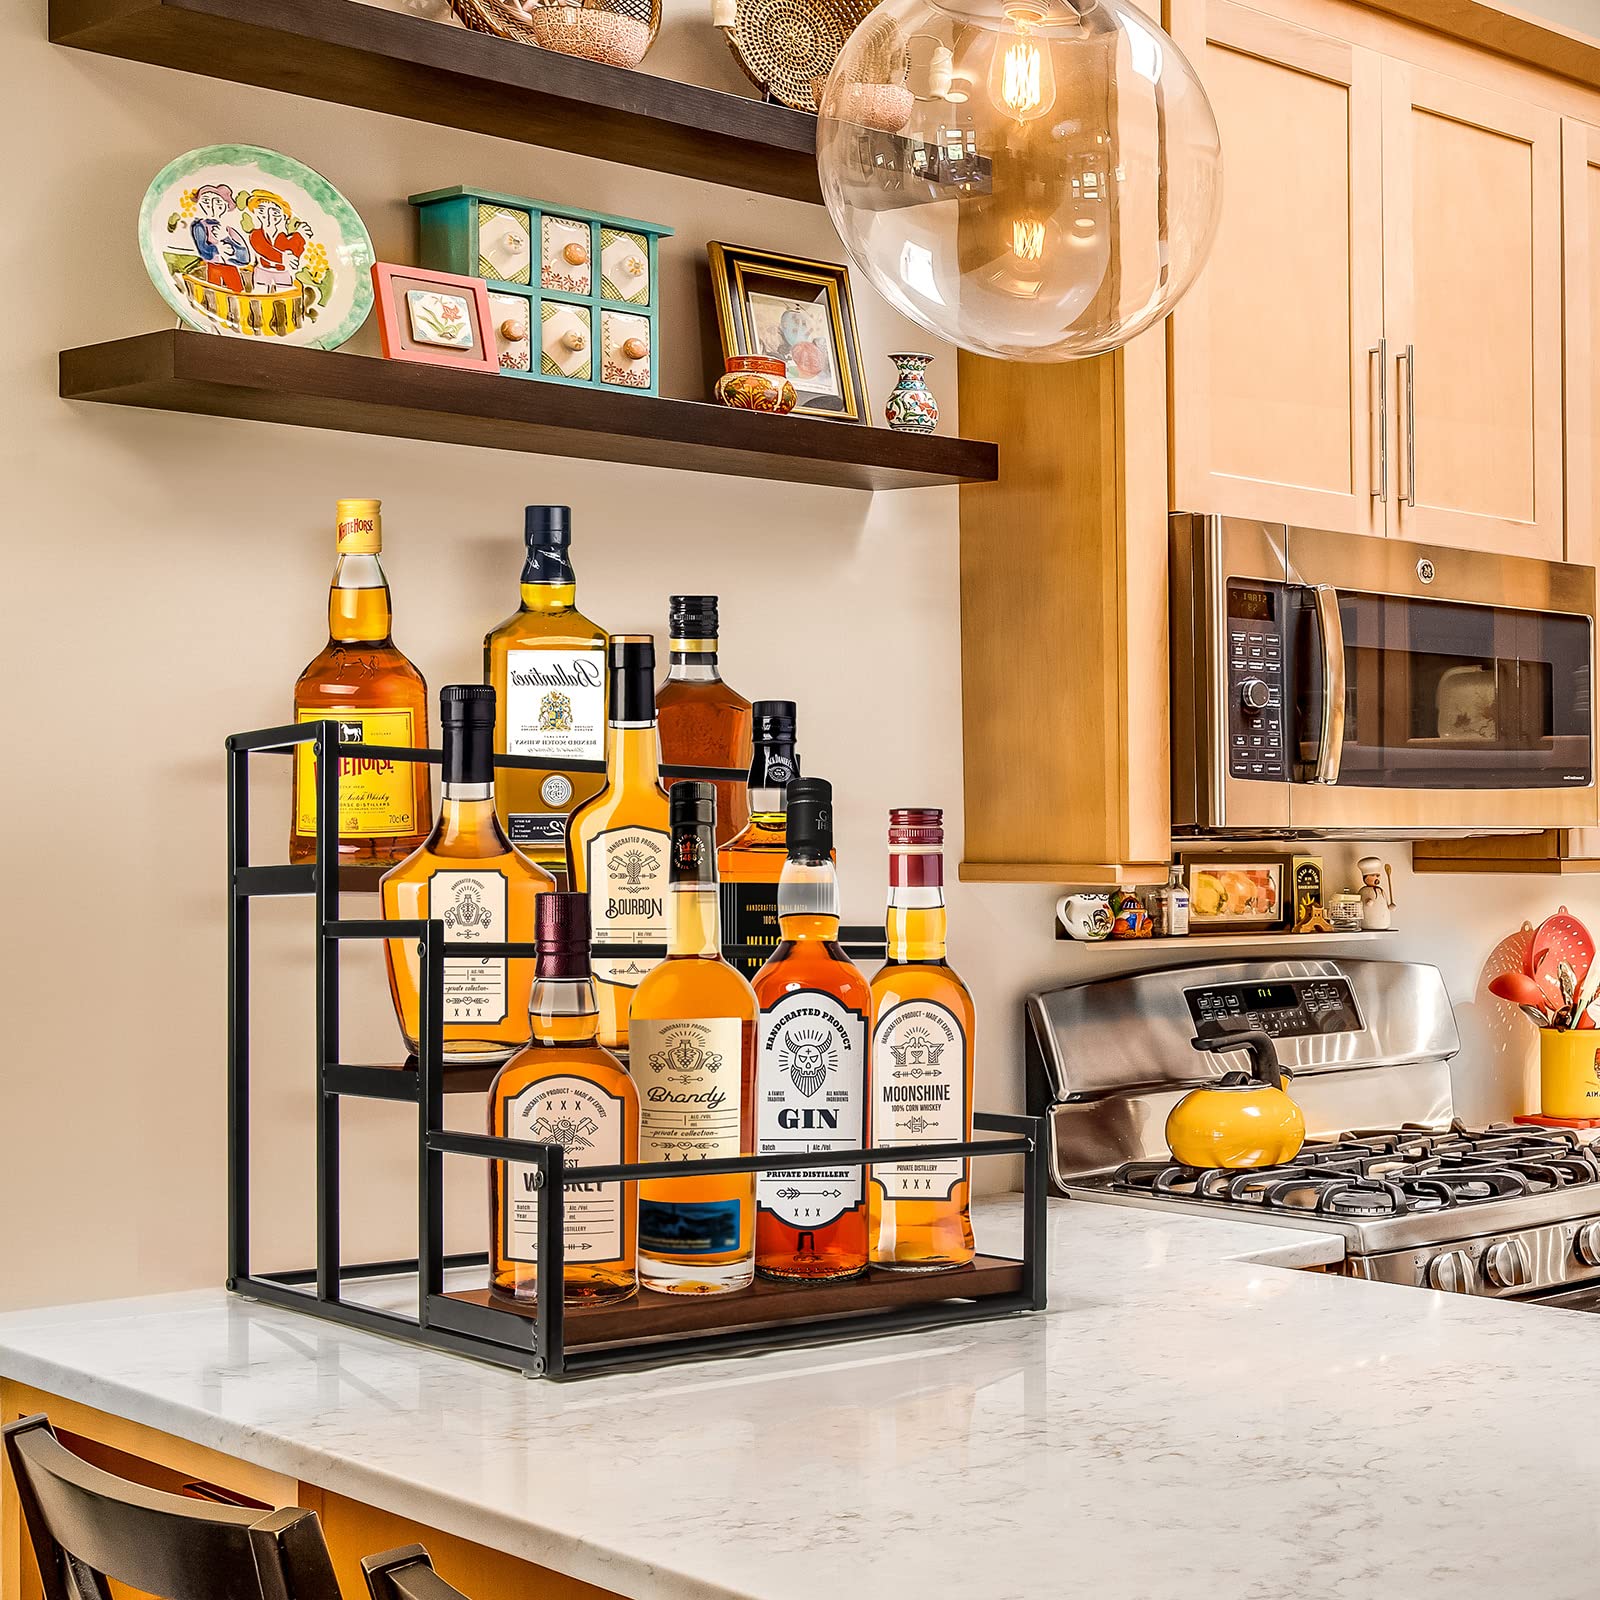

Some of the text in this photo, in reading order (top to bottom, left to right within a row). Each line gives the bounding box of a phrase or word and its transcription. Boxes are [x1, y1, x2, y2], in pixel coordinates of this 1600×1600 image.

[606, 836, 662, 854] HANDCRAFTED PRODUCT
[606, 898, 662, 919] BOURBON
[763, 916, 776, 924] 100%
[454, 1008, 482, 1016] X X X
[659, 1024, 712, 1035] HANDCRAFTED PRODUCT
[766, 1008, 852, 1050] HANDCRAFTED PRODUCT
[881, 1017, 902, 1044] HANDCRAFTED
[902, 1010, 922, 1020] PRODUCT
[926, 1012, 938, 1022] MADE
[941, 1022, 954, 1042] EXPERTS
[647, 1086, 726, 1109] Brandy
[883, 1084, 950, 1102] MOONSHINE
[522, 1092, 547, 1118] HANDCRAFTED
[546, 1088, 569, 1097] PRODUCT
[574, 1090, 588, 1098] MADE
[593, 1101, 606, 1118] EXPERTS
[546, 1101, 581, 1110] X X X
[778, 1108, 839, 1129] GIN
[902, 1180, 931, 1189] X X X
[794, 1208, 820, 1216] X X X
